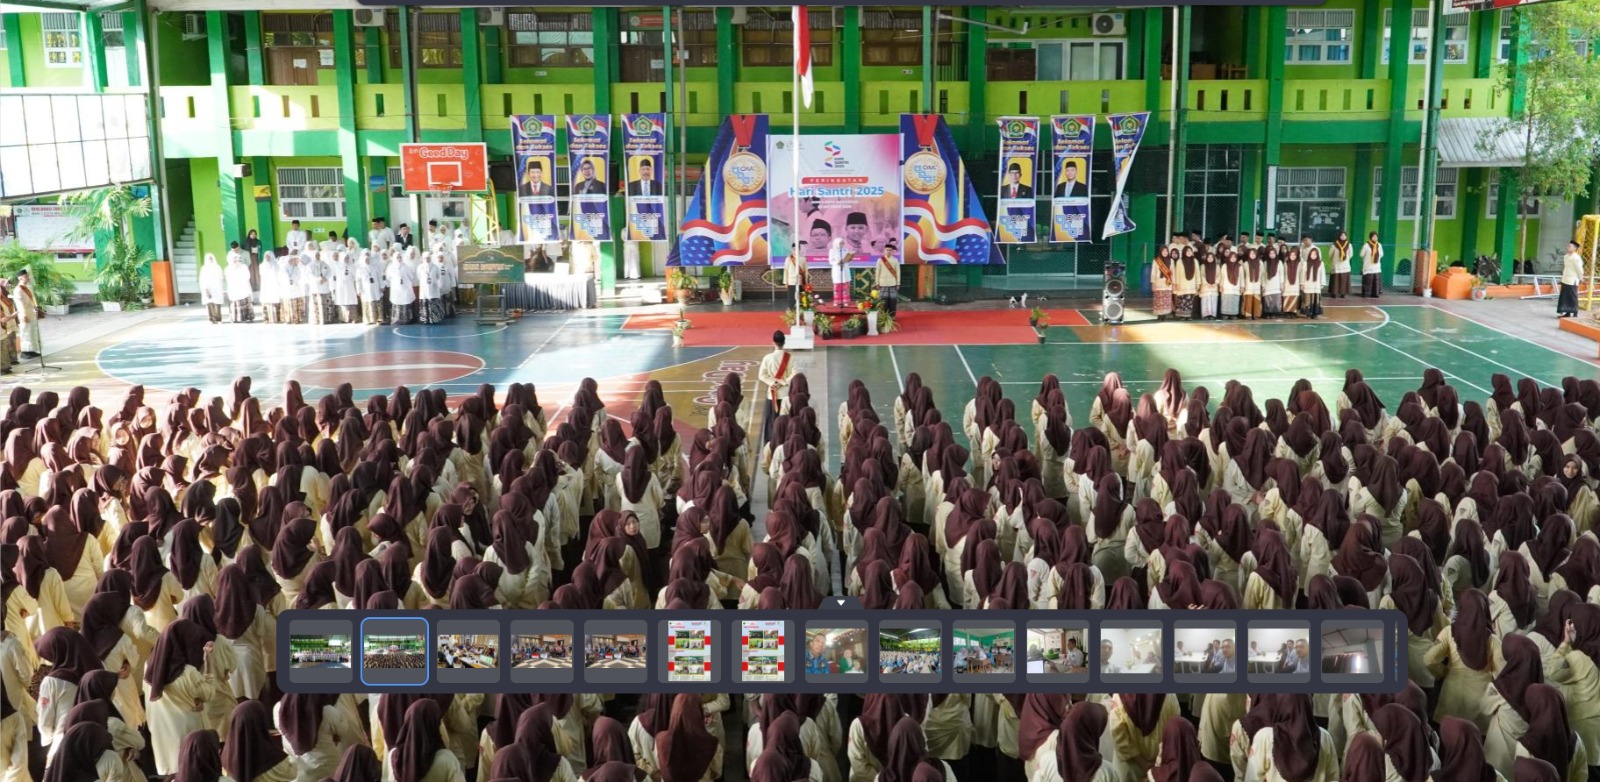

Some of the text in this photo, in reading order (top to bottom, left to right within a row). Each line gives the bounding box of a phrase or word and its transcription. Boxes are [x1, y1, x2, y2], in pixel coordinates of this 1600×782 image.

[419, 146, 447, 158] Good
[447, 147, 469, 160] Day
[789, 186, 885, 196] Hari Santri 2025
